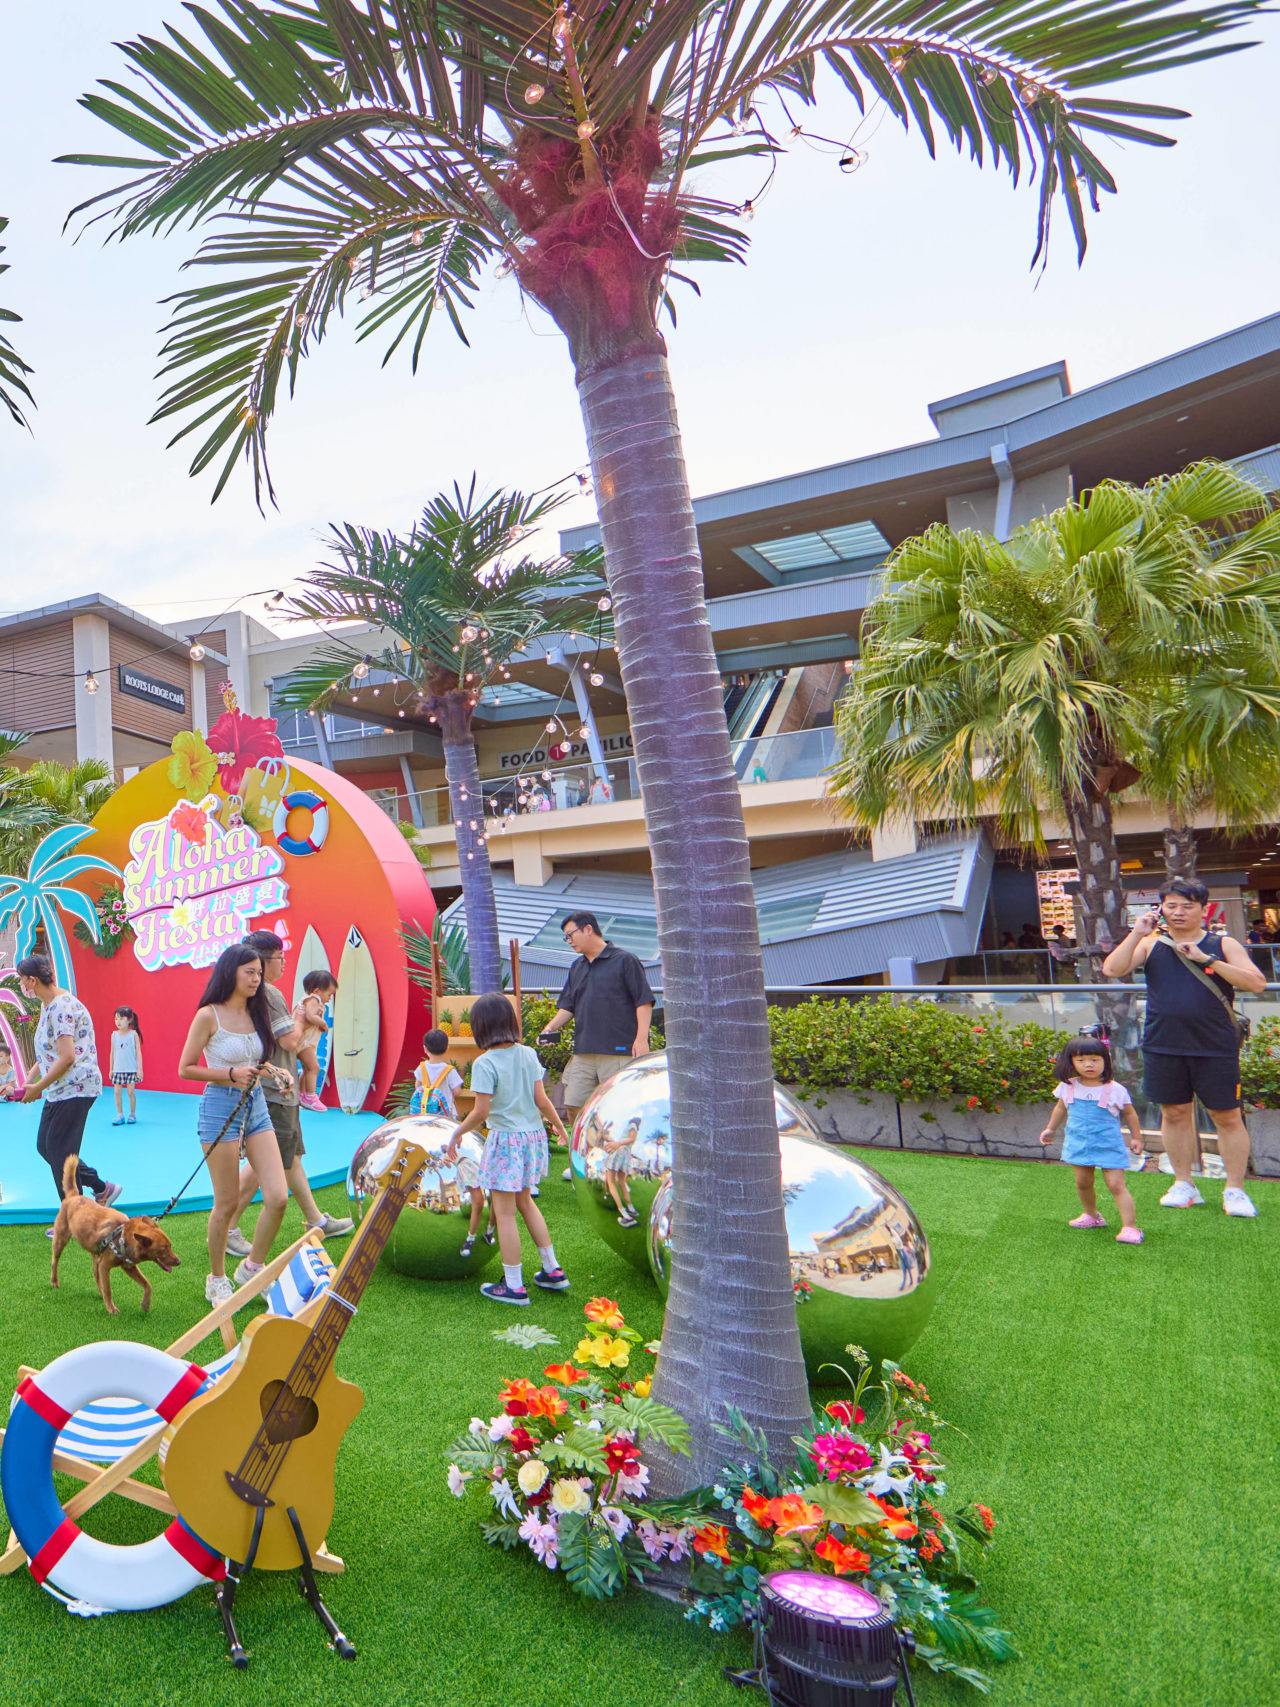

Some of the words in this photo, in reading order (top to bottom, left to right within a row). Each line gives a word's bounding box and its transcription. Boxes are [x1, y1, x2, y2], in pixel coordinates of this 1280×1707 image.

[124, 674, 147, 691] ROOTS
[147, 683, 169, 699] LODGE
[501, 750, 545, 768] FOOD
[126, 820, 249, 886] Aloha
[126, 849, 268, 913] Summer
[136, 911, 237, 957] Fiesta
